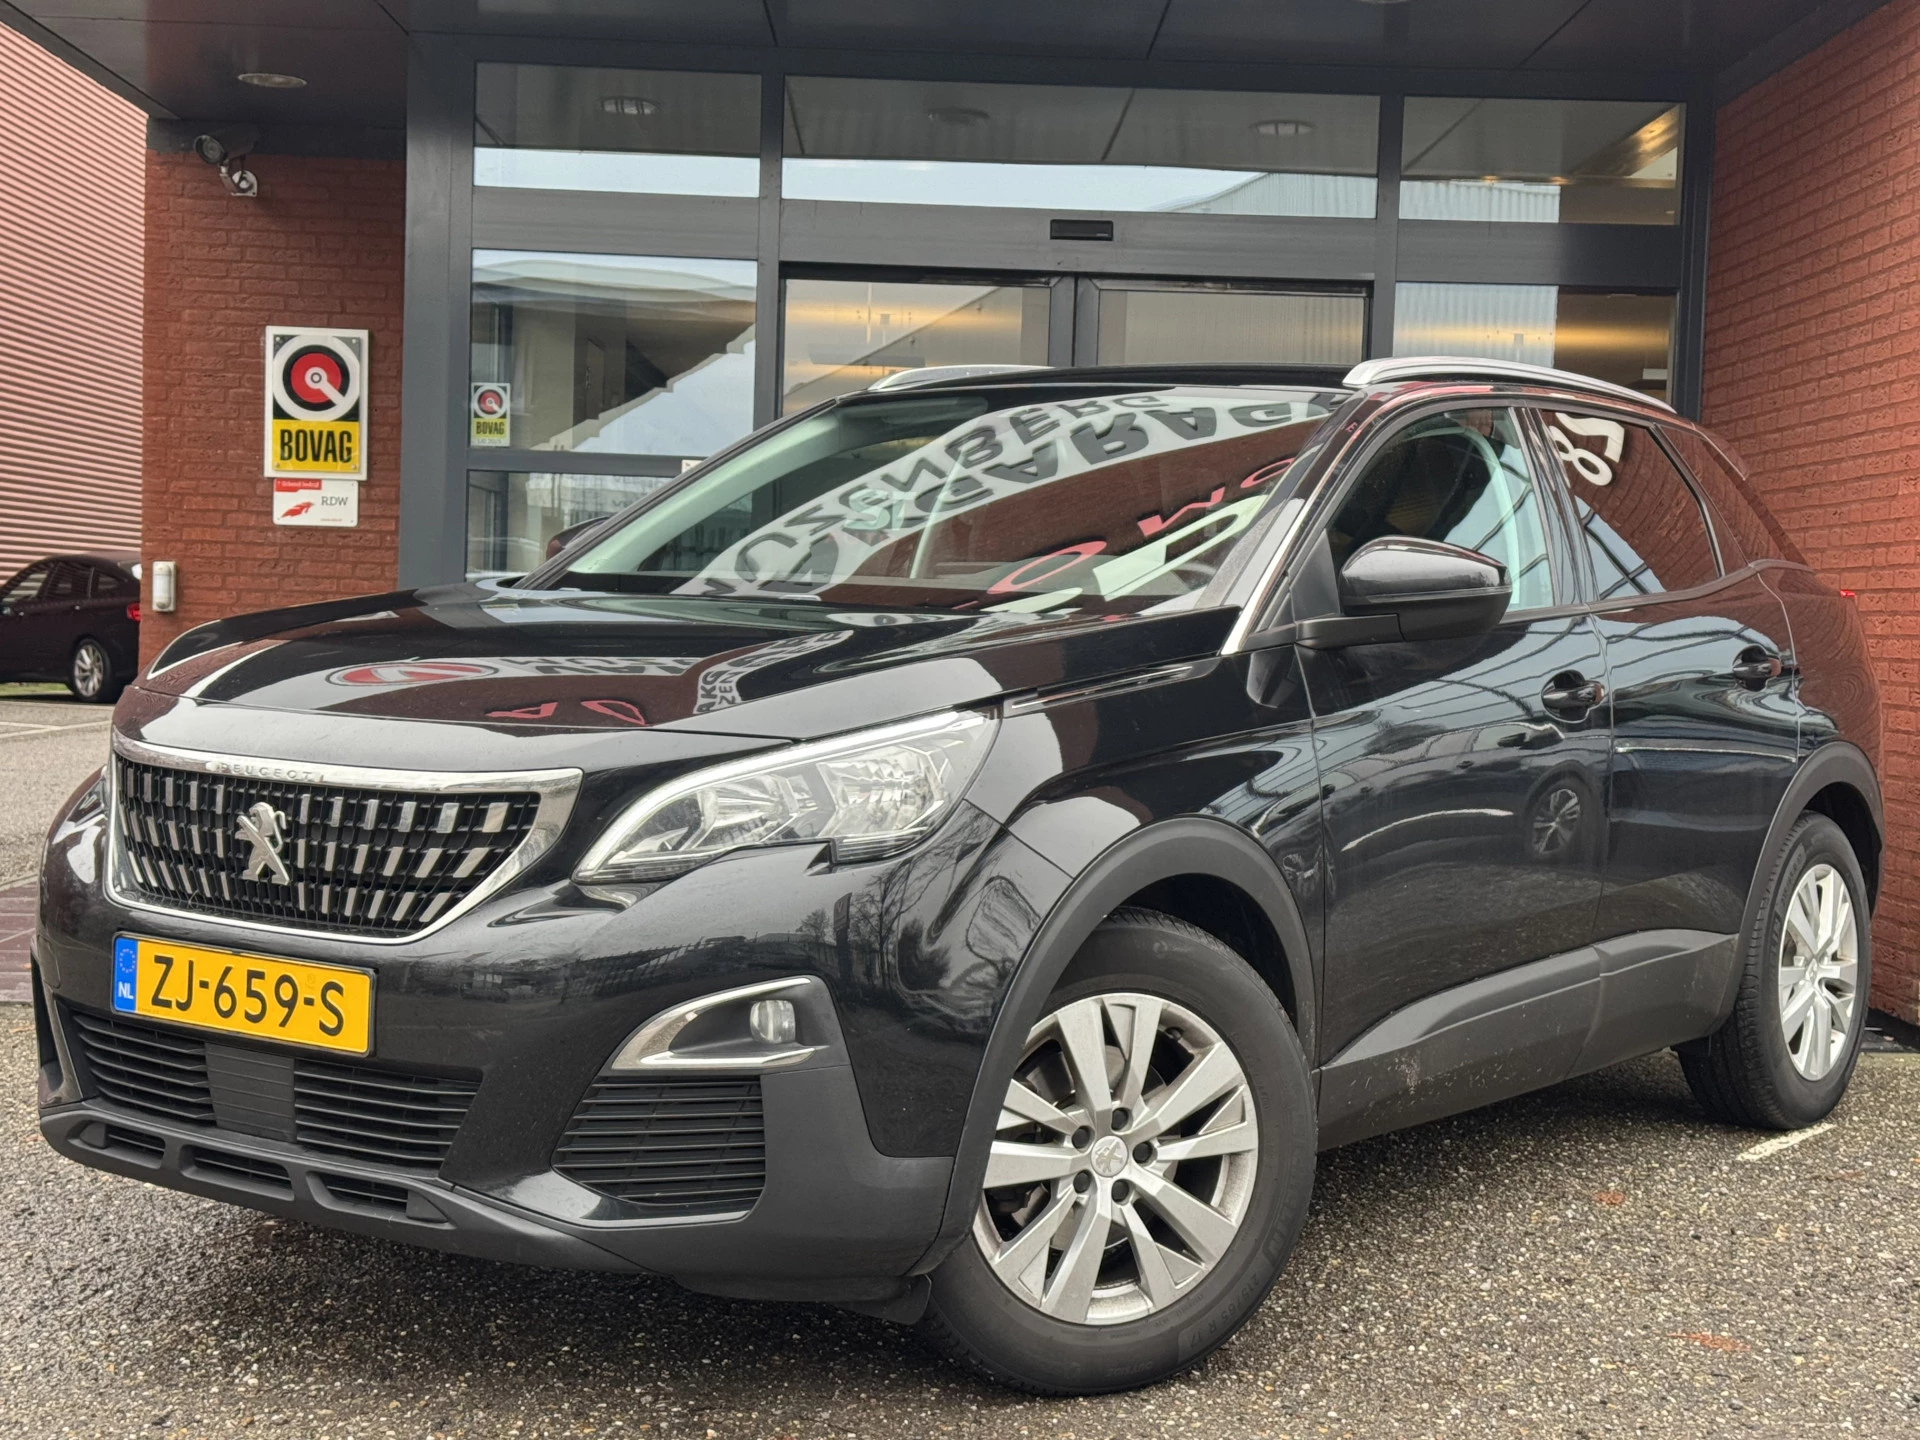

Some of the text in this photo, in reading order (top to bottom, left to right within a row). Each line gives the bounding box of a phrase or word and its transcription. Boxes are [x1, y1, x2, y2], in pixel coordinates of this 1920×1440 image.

[476, 421, 505, 435] BOVAG
[280, 429, 352, 463] BOVAG
[320, 495, 348, 507] RDW
[217, 763, 312, 782] PEUGEOT
[118, 981, 134, 1000] NL
[151, 954, 344, 1037] ZJ-659-S
